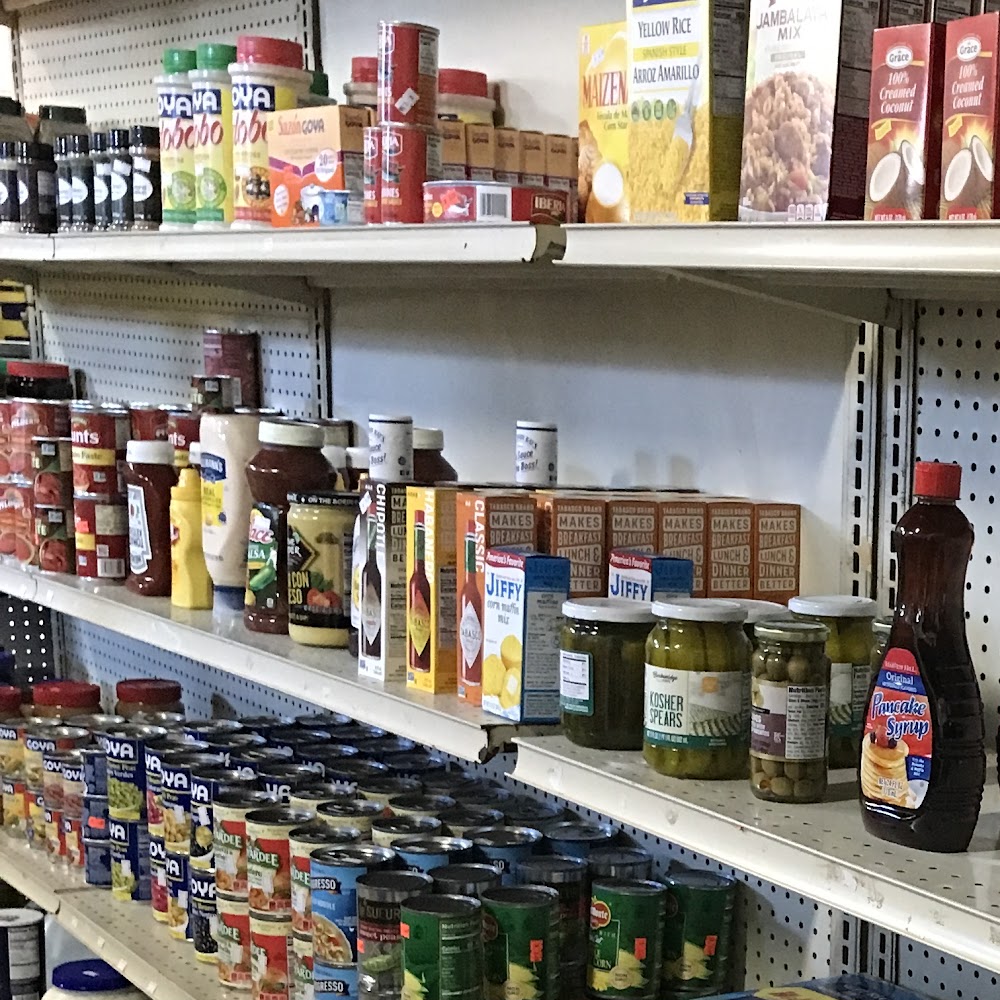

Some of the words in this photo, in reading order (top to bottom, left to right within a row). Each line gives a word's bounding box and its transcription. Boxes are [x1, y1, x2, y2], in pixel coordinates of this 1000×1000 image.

[638, 19, 670, 38] YELLOW
[672, 16, 691, 34] RICE
[777, 27, 800, 41] MIX
[642, 48, 668, 59] SPANISH
[669, 46, 688, 56] STYLE
[959, 44, 978, 54] Grace
[889, 53, 909, 63] Grace
[633, 67, 656, 84] ARROZ
[657, 64, 699, 81] AMARILLO
[958, 63, 978, 79] 100%
[888, 72, 909, 85] 100%
[952, 76, 984, 95] Creamed
[582, 70, 628, 108] MAIZEN
[880, 85, 916, 100] Creamed
[880, 100, 914, 114] Coconut
[952, 94, 982, 109] Coconut
[492, 515, 532, 527] MAKES
[559, 516, 600, 527] MAKES
[615, 517, 653, 528] MAKES
[665, 519, 701, 528] MAKES
[714, 520, 748, 530] MAKES
[761, 521, 795, 531] MAKES
[474, 499, 484, 573] CLASSIC
[491, 530, 533, 545] BREAKFAST
[558, 532, 600, 546] BREAKFAST
[612, 533, 653, 547] BREAKFAST
[664, 532, 702, 547] BREAKFAST
[712, 533, 750, 547] BREAKFAST
[760, 534, 794, 548] BREAKFAST
[486, 552, 506, 563] America's
[507, 555, 524, 568] Favorite
[713, 548, 739, 560] LUNCH
[761, 550, 787, 561] LUNCH
[712, 563, 749, 577] DINNER
[760, 564, 795, 577] DINNER
[486, 573, 522, 601] JIFFY
[610, 574, 648, 600] JIFFY
[713, 579, 747, 589] BETTER
[760, 580, 793, 589] BETTER
[487, 600, 500, 610] corn
[502, 602, 519, 615] muffin
[498, 614, 510, 625] mix
[886, 672, 914, 685] Original
[650, 691, 684, 712] KOSHER
[871, 691, 927, 720] Pancake
[650, 709, 683, 728] SPEARS
[886, 716, 929, 740] Syrup
[27, 740, 55, 751] GOYA
